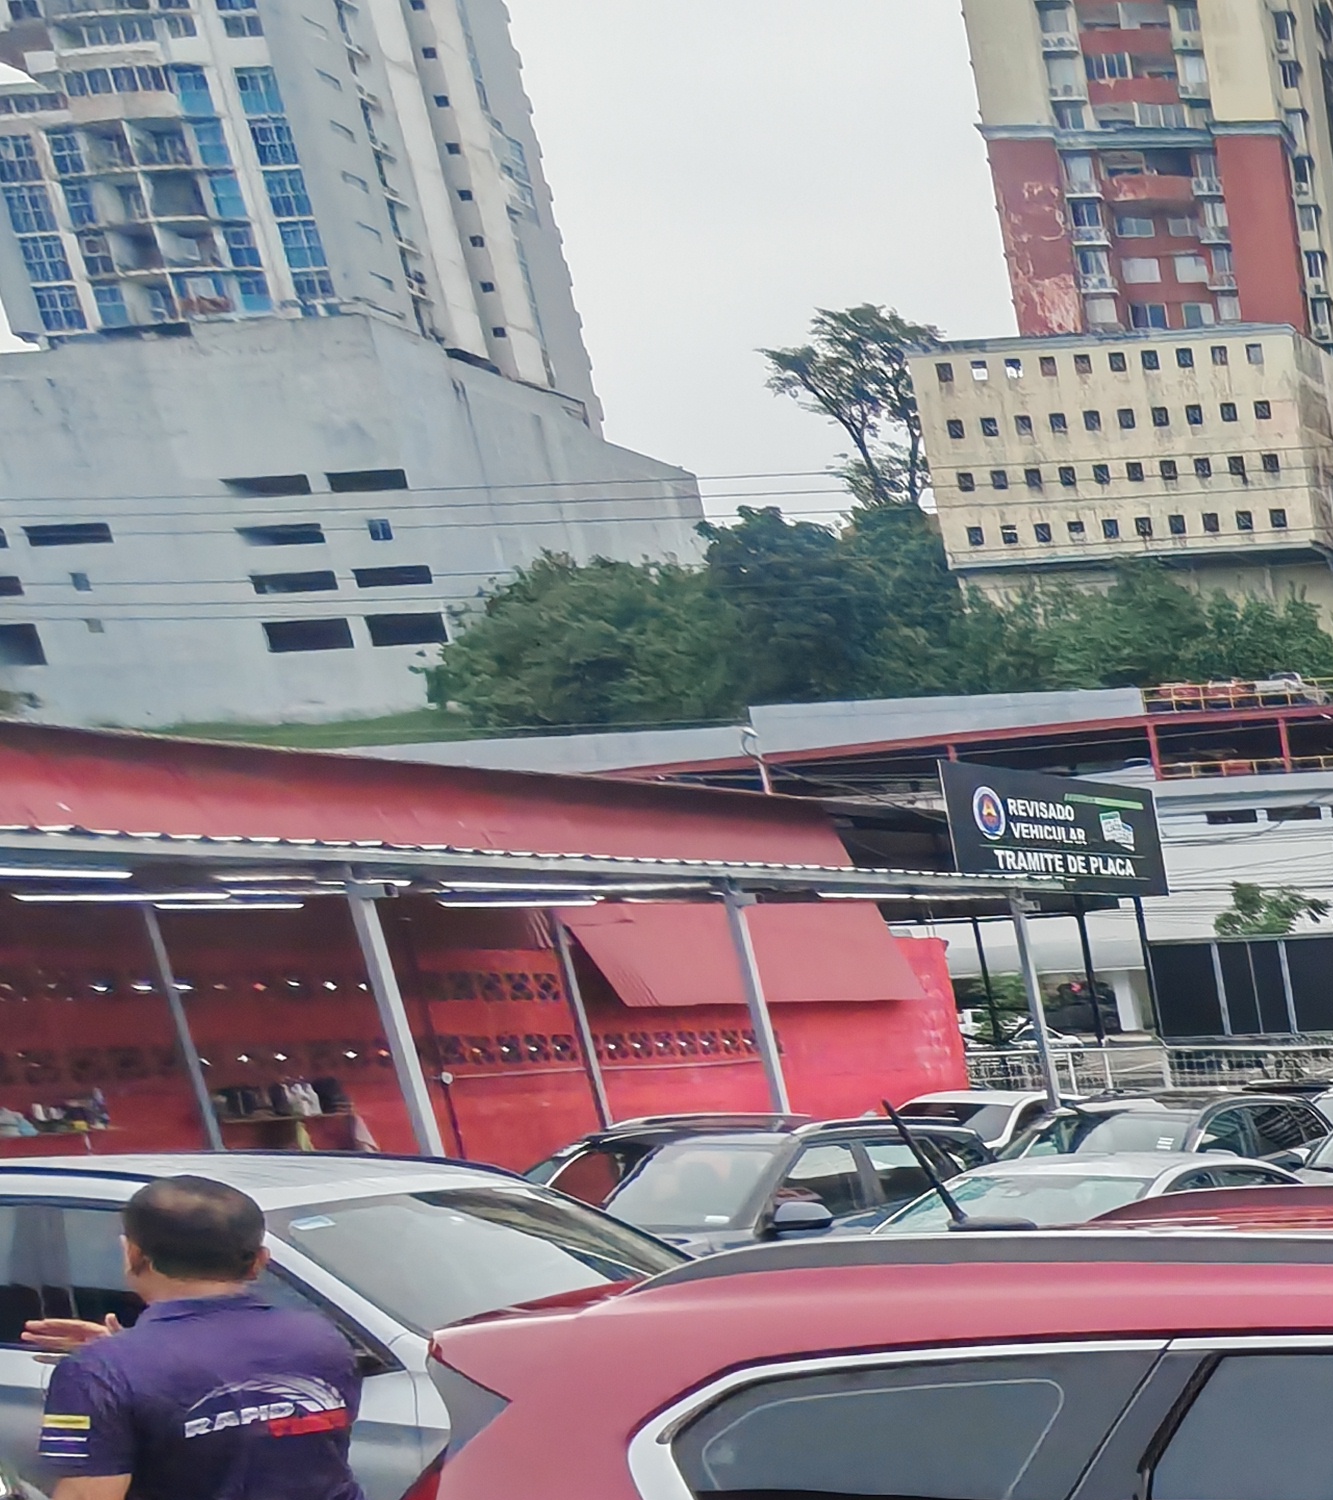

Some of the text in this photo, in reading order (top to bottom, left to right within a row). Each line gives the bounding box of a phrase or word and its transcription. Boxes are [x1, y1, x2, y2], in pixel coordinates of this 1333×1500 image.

[1006, 797, 1075, 822] REVISADO
[1009, 821, 1088, 846] VEHICULAR
[993, 849, 1136, 878] TRAMITE DE PLACA
